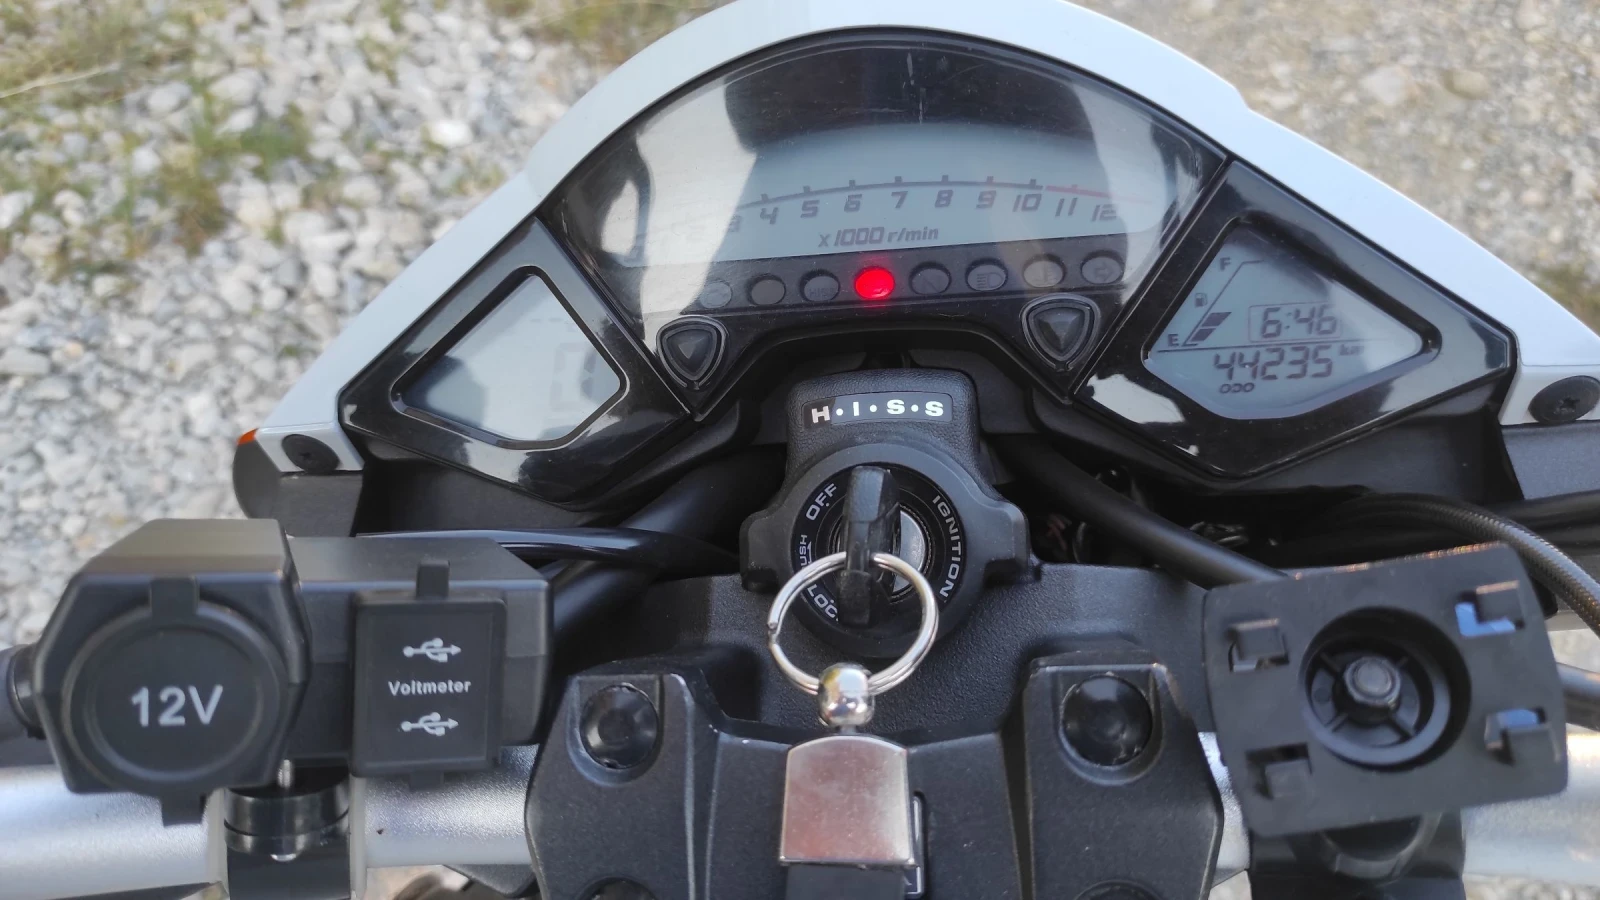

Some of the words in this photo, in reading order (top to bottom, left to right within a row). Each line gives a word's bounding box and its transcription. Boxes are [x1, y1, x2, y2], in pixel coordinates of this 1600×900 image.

[759, 207, 780, 225] 4
[800, 199, 820, 219] 5
[843, 193, 863, 213] 6
[890, 190, 908, 209] 7
[934, 189, 953, 208] 8
[975, 189, 997, 210] 9
[1012, 193, 1042, 213] 10
[1055, 197, 1078, 219] 11
[1090, 203, 1117, 223] 12
[886, 226, 939, 244] r/min
[1219, 257, 1231, 272] F
[1261, 305, 1337, 339] 6:46
[1167, 333, 1180, 347] E
[1213, 344, 1333, 381] 44235
[805, 483, 838, 521] OFF
[799, 534, 808, 568] USH
[932, 495, 962, 603] IGNITION
[807, 583, 839, 622] LOC
[387, 678, 472, 697] Voltmeter
[130, 684, 224, 728] 12V
